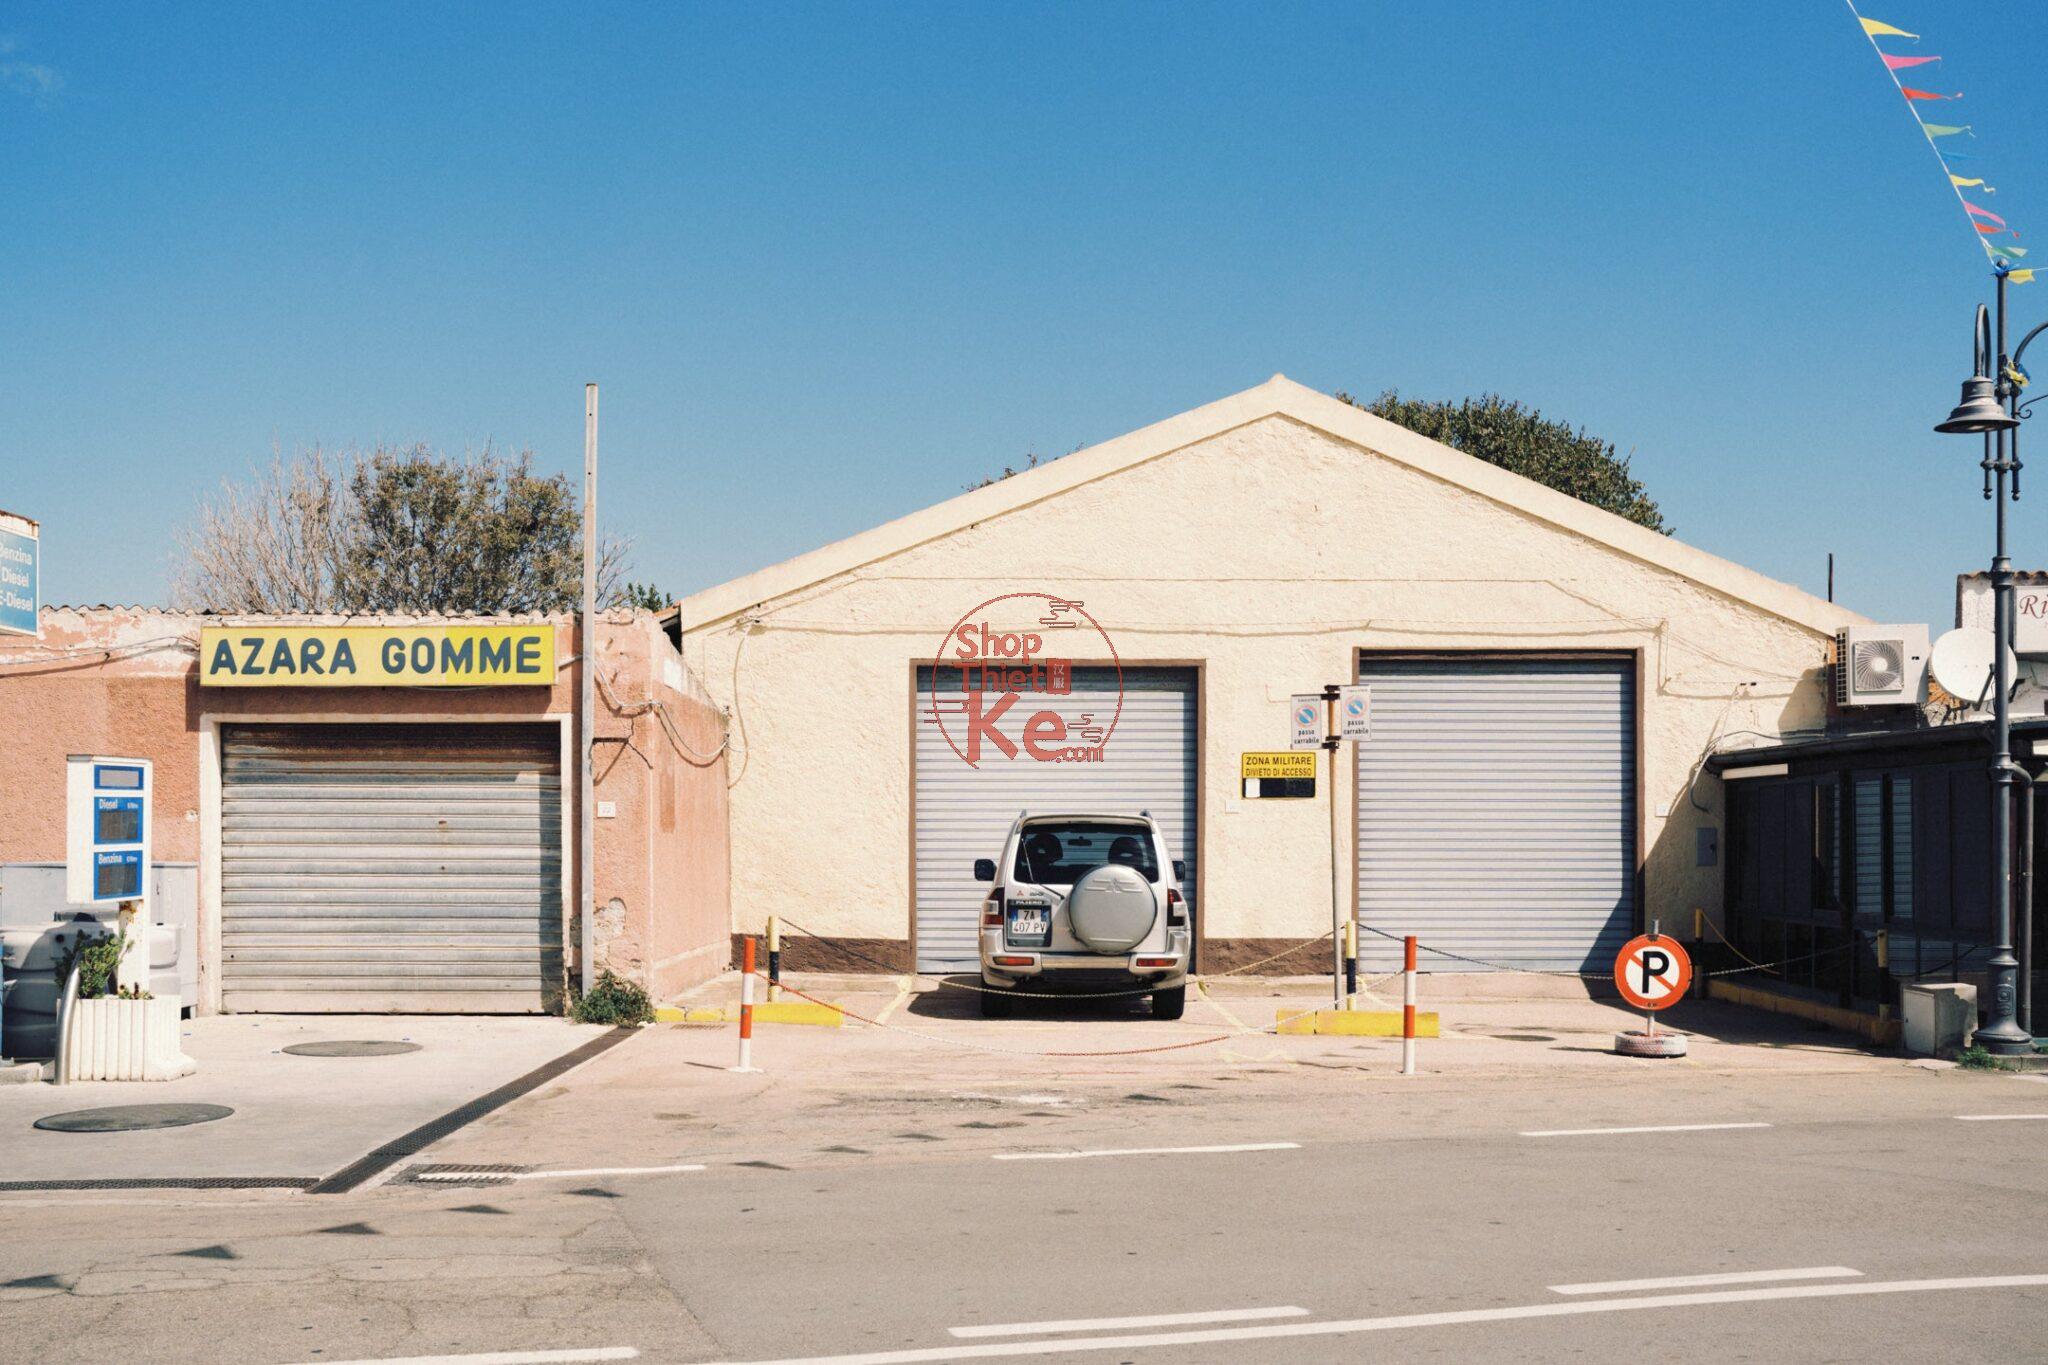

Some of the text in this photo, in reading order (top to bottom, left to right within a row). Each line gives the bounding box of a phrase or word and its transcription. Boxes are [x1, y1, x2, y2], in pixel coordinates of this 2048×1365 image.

[209, 636, 541, 674] AZARA GOMME
[1245, 768, 1312, 776] DIVIETO DI ACCESSO
[1246, 756, 1312, 765] ZONA MILITARE
[1642, 951, 1669, 993] P
